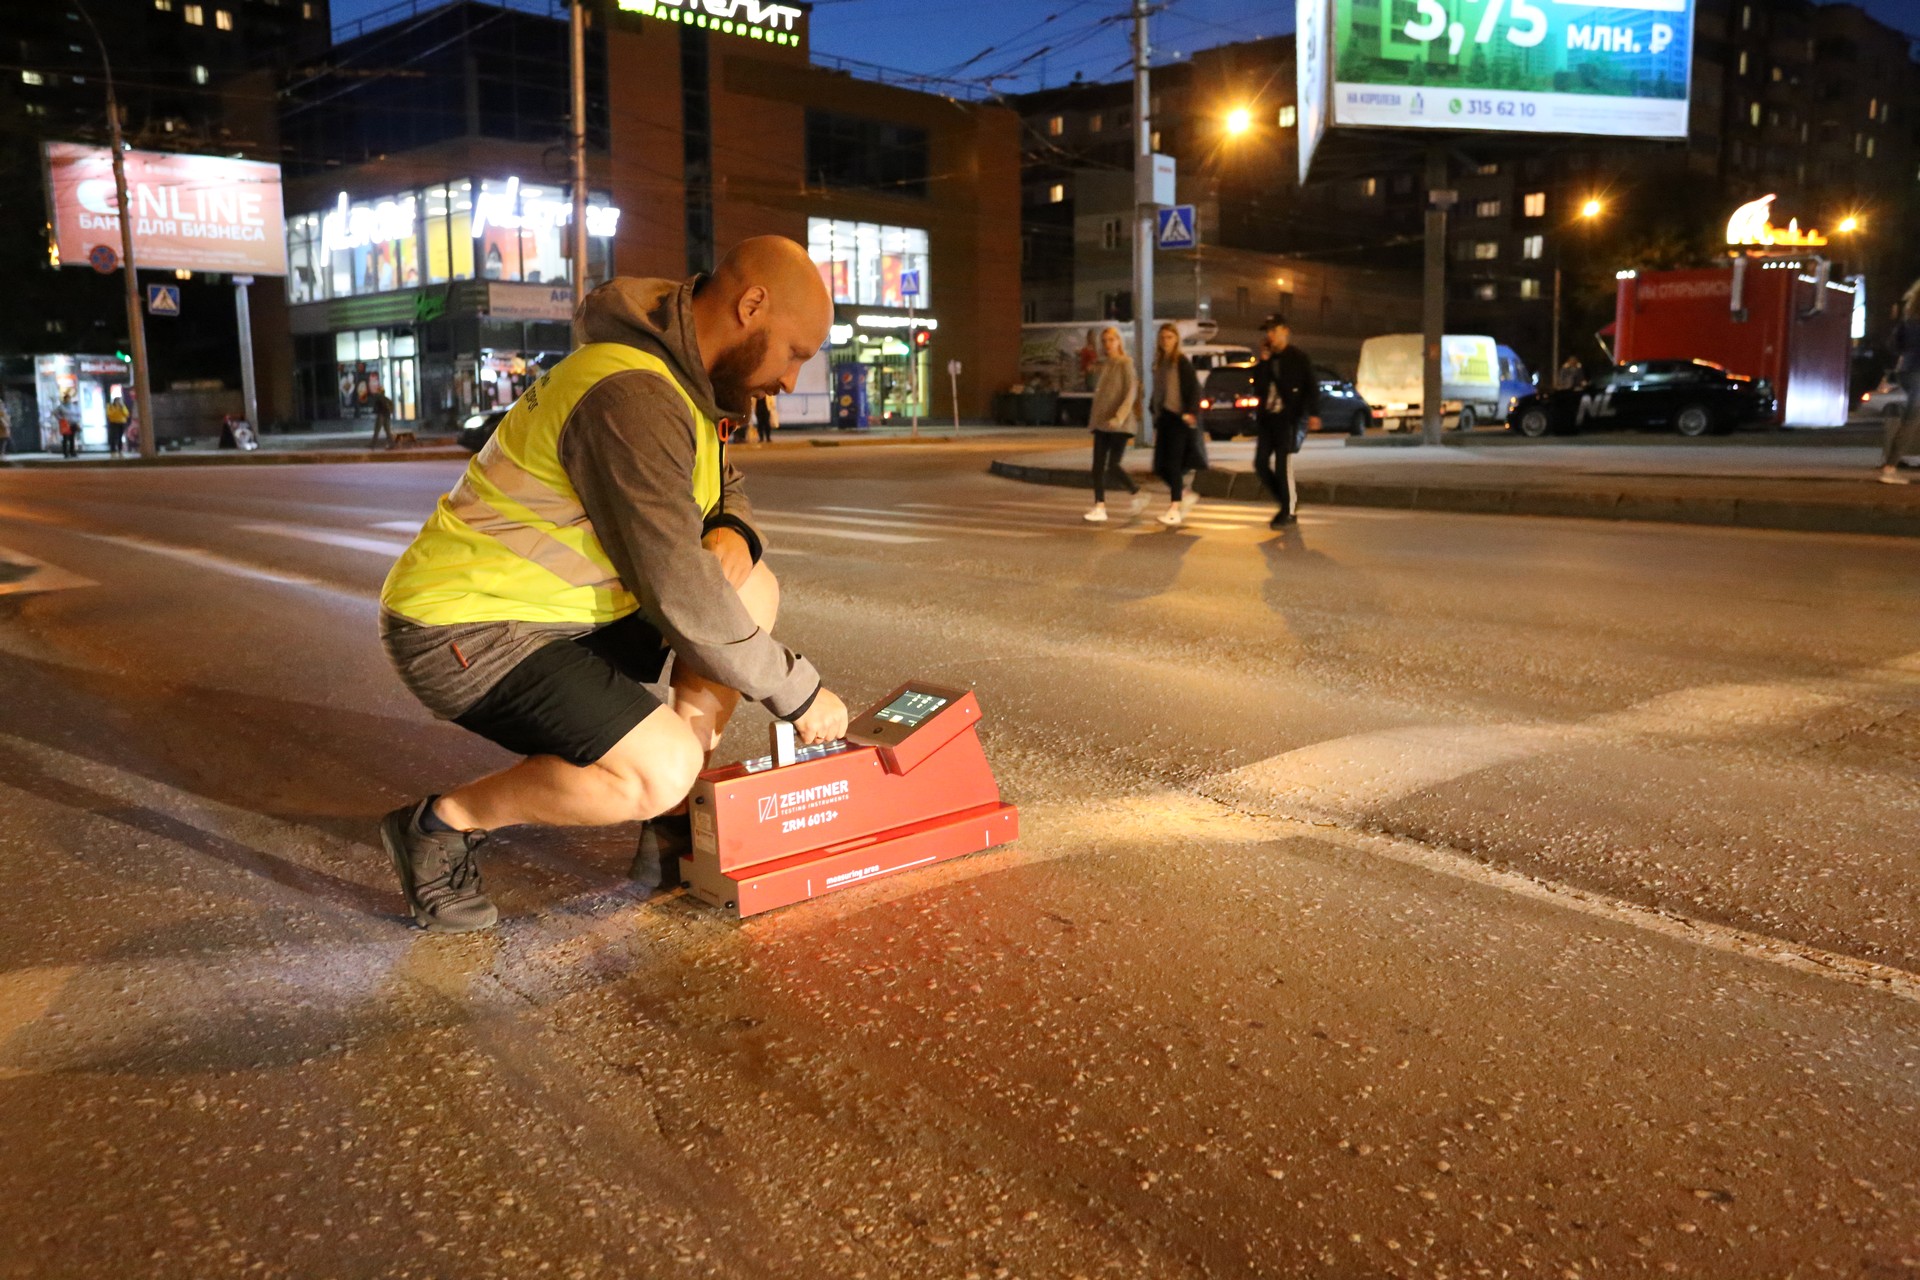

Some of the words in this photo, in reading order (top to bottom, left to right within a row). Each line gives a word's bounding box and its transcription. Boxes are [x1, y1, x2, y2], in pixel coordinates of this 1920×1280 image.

[1566, 23, 1641, 53] МЛН.
[1467, 100, 1492, 114] 315
[1497, 102, 1515, 115] 62
[1521, 103, 1536, 117] 10
[79, 213, 120, 231] БАН
[137, 219, 177, 237] ДЛЯ
[181, 223, 266, 241] БИЗНЕСА
[779, 779, 849, 809] ZEHNTNER
[780, 804, 807, 815] TESTING
[807, 794, 849, 809] INSTRUMENTS
[782, 816, 806, 834] ZRM
[807, 810, 839, 827] 6013+
[826, 869, 863, 885] measuring
[863, 864, 880, 875] area
